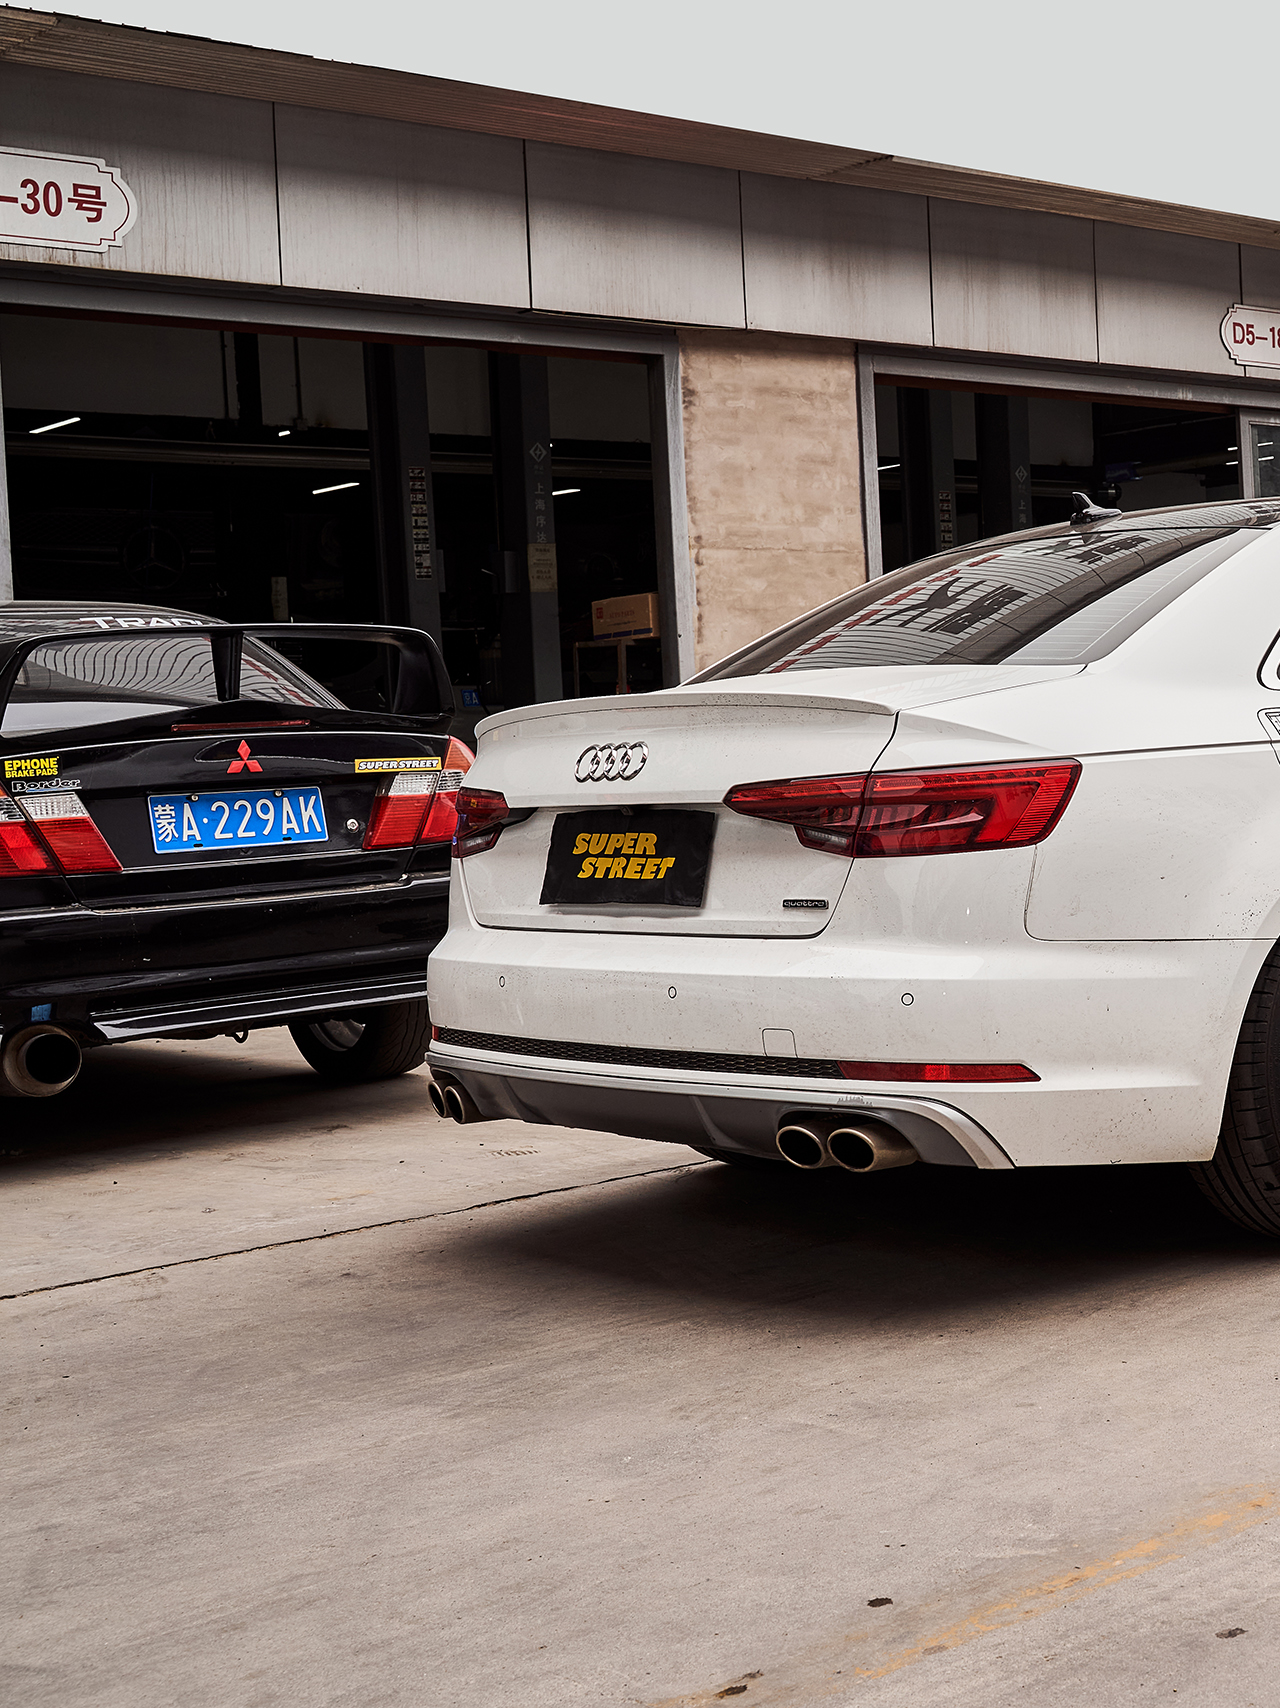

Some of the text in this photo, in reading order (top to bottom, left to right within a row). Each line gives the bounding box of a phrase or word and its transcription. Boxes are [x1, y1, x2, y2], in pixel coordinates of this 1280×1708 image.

[4, 758, 58, 771] EPHONE
[358, 760, 439, 771] SUPER STREET
[5, 768, 58, 778] BRAKE PADS
[11, 778, 81, 793] Border
[572, 832, 658, 855] SUPER
[577, 856, 676, 880] STREET
[783, 900, 825, 908] quattro
